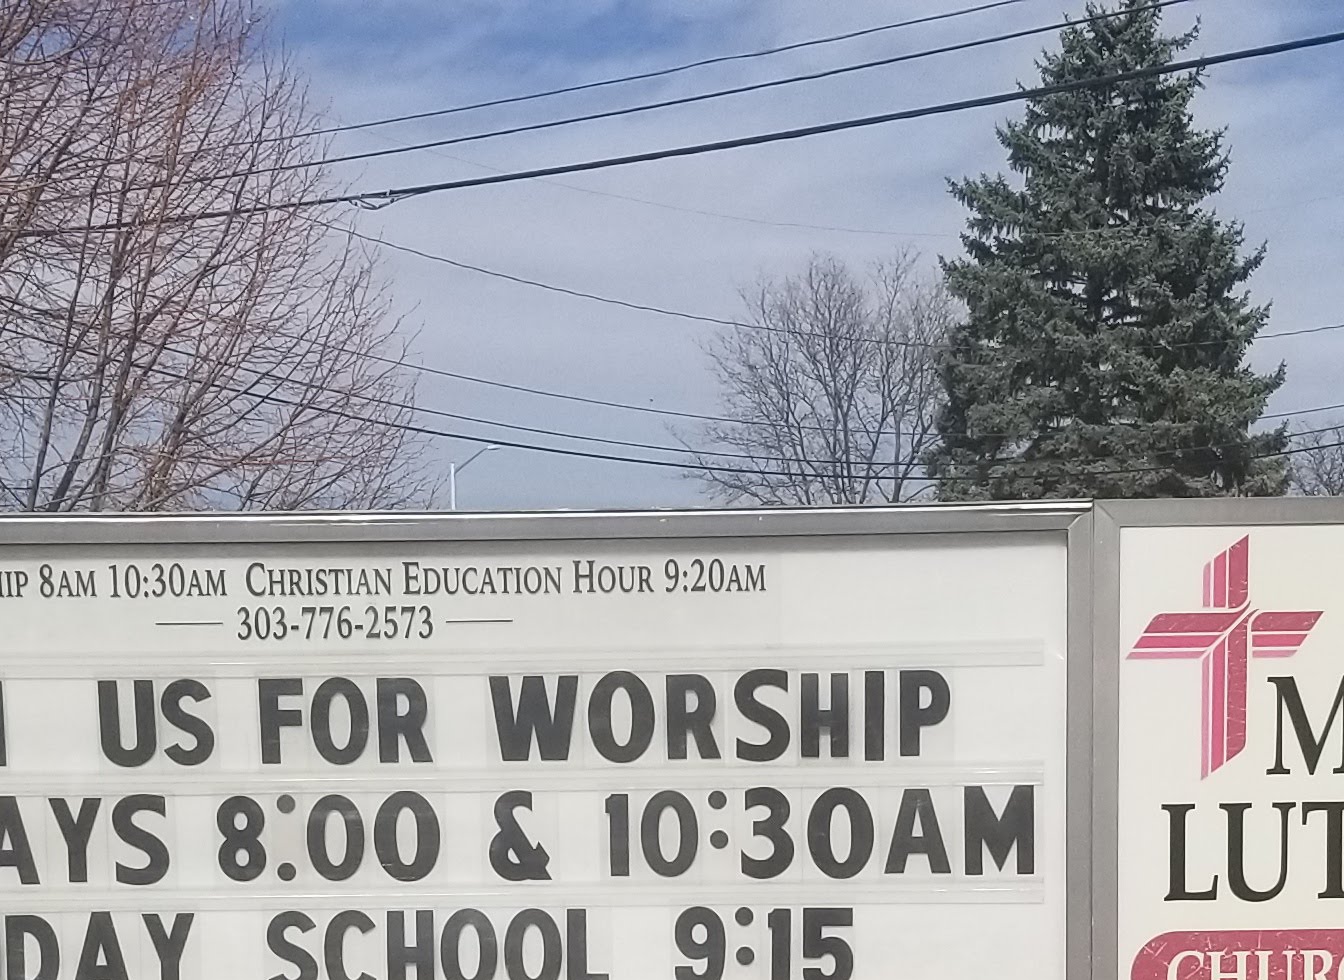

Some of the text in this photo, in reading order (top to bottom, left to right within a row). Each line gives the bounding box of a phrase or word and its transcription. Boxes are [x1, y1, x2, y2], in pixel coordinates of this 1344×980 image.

[237, 605, 434, 641] 303-776-2573
[97, 678, 215, 768] US
[257, 676, 434, 766] FOR
[488, 668, 951, 764] WORSHIP
[216, 790, 441, 882] 8:00
[488, 789, 553, 882] &
[604, 784, 1035, 880] 10:30AM
